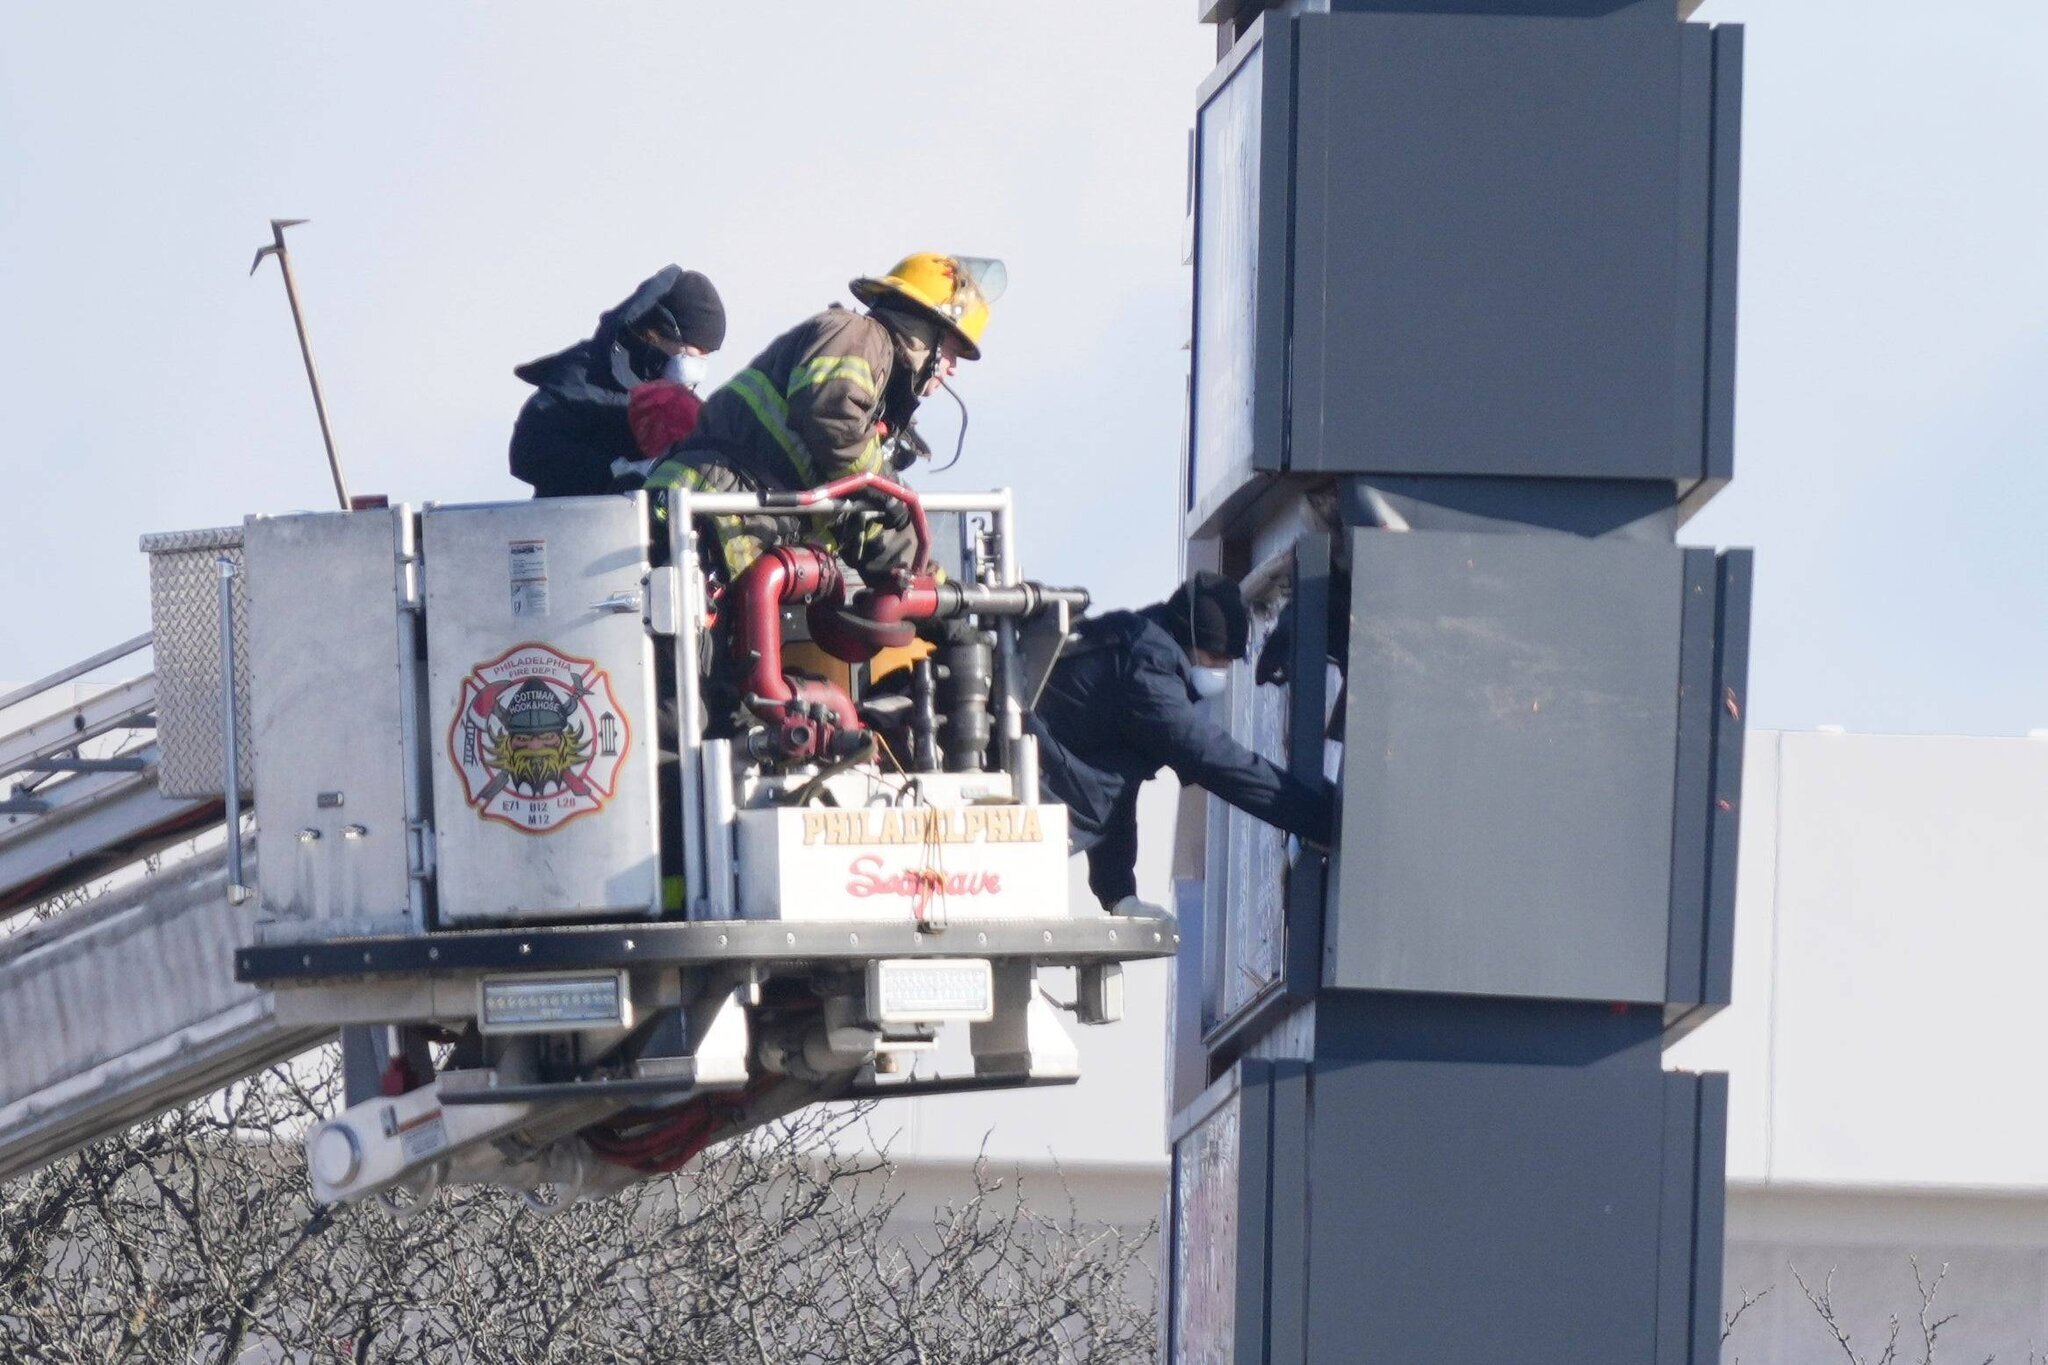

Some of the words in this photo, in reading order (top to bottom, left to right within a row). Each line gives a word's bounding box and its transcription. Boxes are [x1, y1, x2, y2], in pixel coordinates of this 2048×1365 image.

[493, 656, 572, 676] PHILADELPHIA
[508, 667, 529, 678] FIRE
[531, 666, 557, 675] DEPT
[513, 690, 555, 702] COTTMAN
[509, 699, 561, 714] HOOK&HOSE
[502, 800, 519, 811] E71
[528, 814, 549, 825] M12
